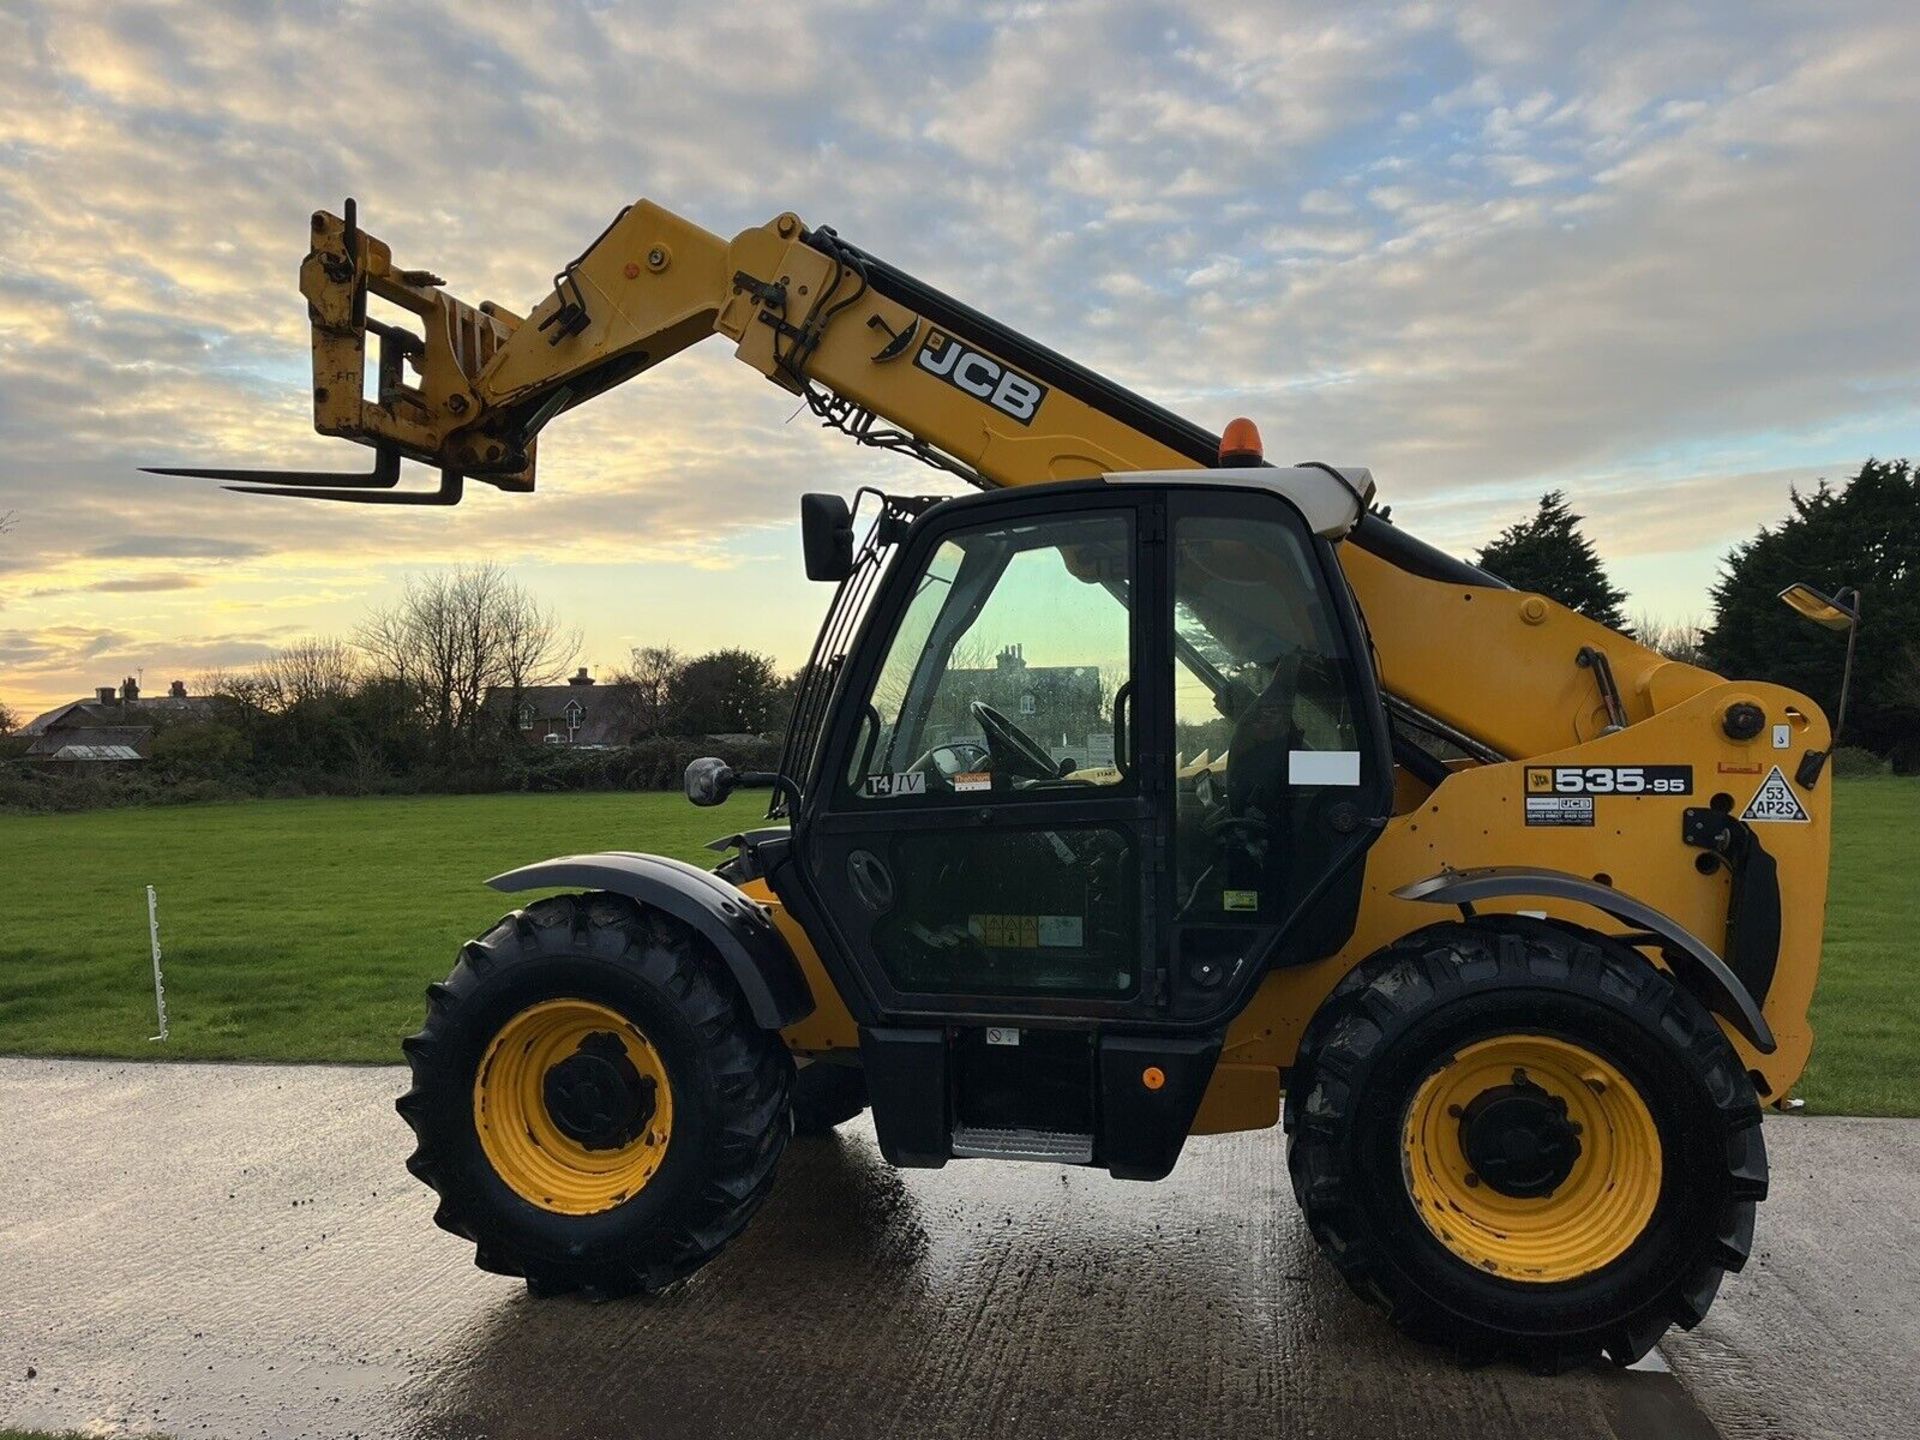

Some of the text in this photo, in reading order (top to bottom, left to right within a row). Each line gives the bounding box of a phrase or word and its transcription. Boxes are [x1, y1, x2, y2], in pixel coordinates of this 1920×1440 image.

[919, 342, 1041, 420] JCB
[868, 774, 922, 794] T4 IV
[1556, 768, 1685, 793] 535-95
[1766, 787, 1784, 801] 53
[1561, 799, 1591, 809] JCB
[1756, 801, 1795, 815] AP2S
